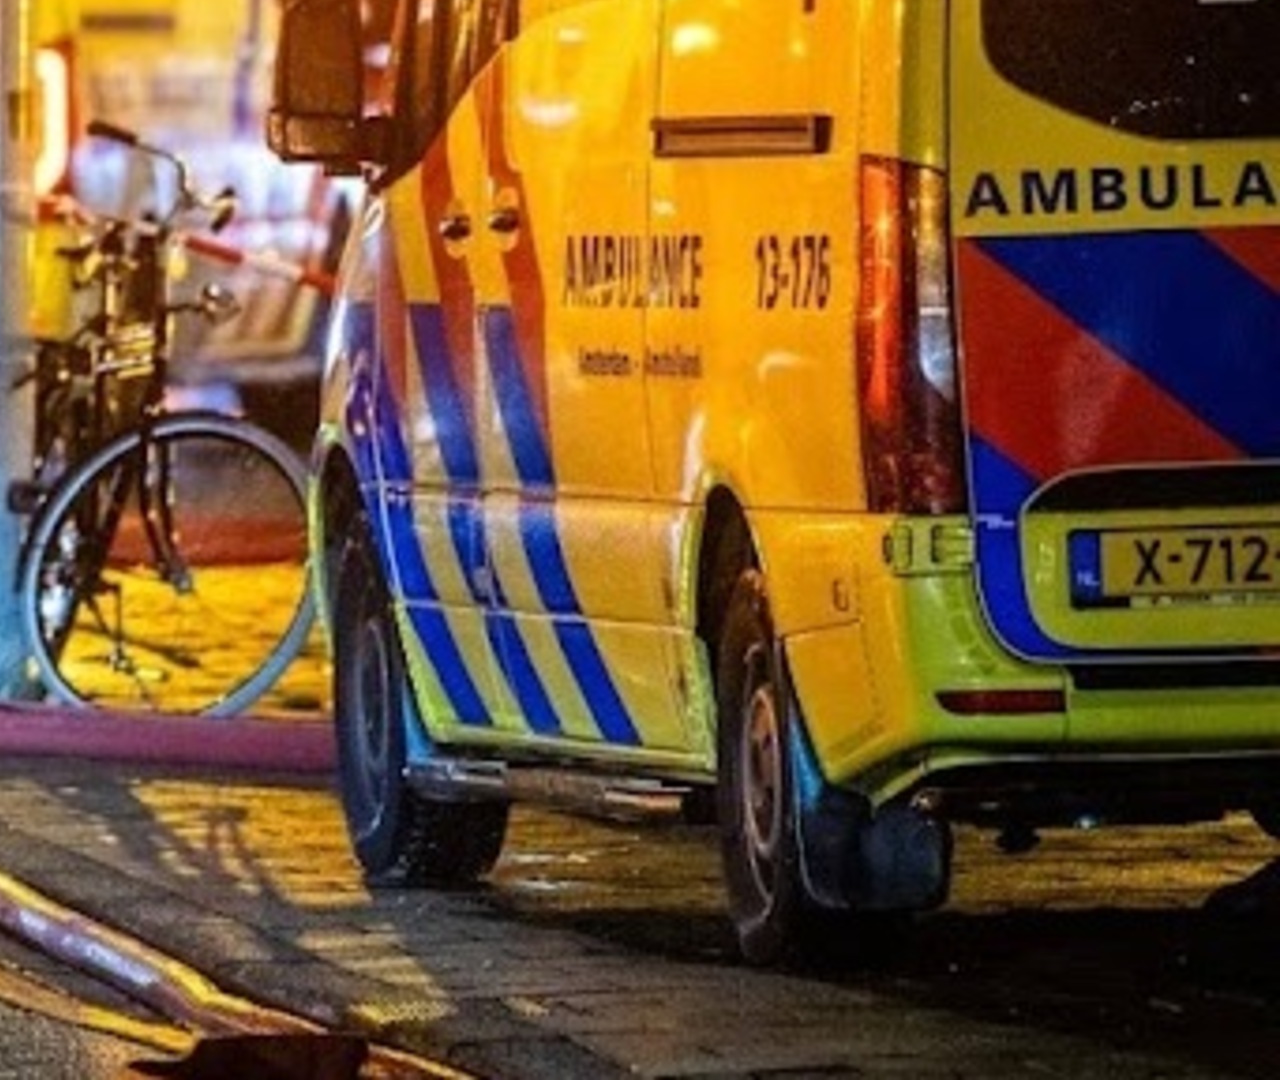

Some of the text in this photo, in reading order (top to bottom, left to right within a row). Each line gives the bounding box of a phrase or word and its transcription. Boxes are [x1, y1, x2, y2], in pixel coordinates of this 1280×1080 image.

[964, 161, 1278, 217] AMBULA
[561, 235, 831, 309] AMBULANCE 13-176
